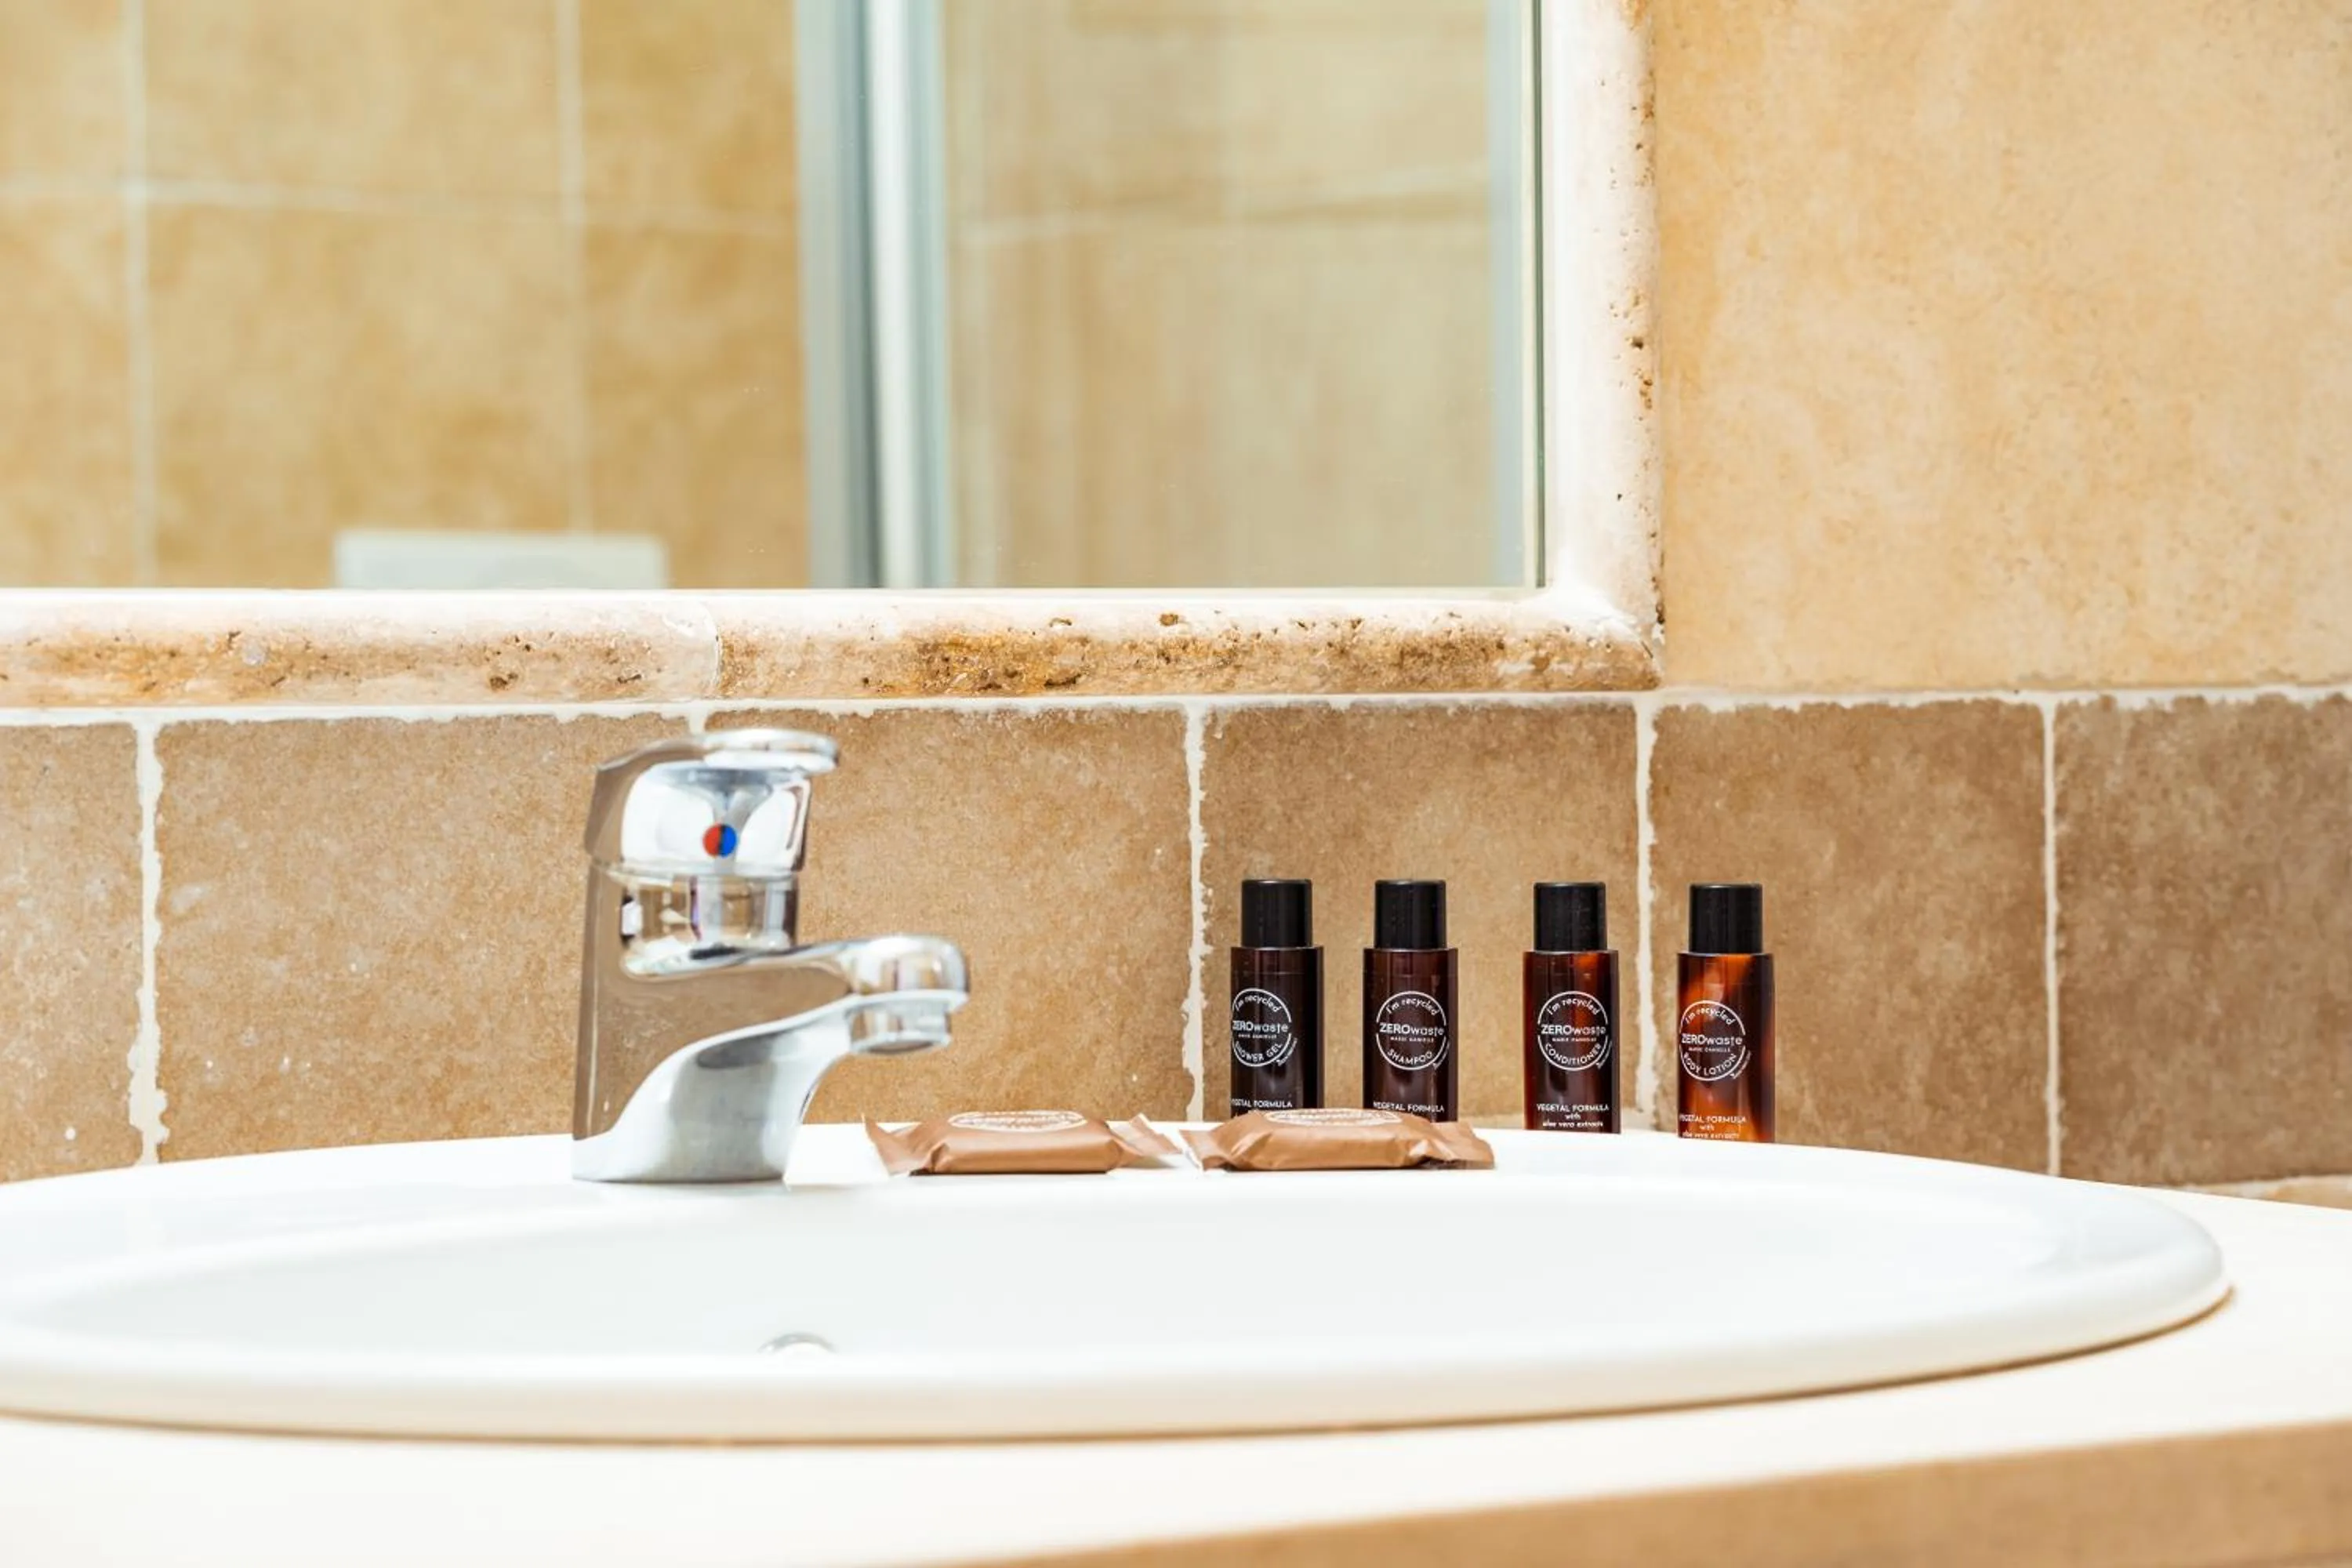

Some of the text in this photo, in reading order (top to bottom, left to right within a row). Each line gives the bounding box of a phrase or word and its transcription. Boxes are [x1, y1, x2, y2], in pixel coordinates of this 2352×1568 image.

[1401, 998, 1441, 1015] recycled
[1562, 998, 1600, 1015] recycled
[1379, 1022, 1445, 1037] ZEROwaste
[1541, 1024, 1606, 1037] ZEROwaste
[1681, 1033, 1743, 1047] ZEROwaste
[1266, 1044, 1283, 1058] GEL
[1387, 1048, 1433, 1065] SHAMPOO
[1545, 1043, 1602, 1065] CONDITIONER
[1703, 1053, 1737, 1076] LOTION
[1254, 1100, 1293, 1109] FORMULA
[1407, 1104, 1445, 1112] FORMULA
[1537, 1103, 1609, 1112] VEGETAL FORMULA
[1707, 1116, 1746, 1124] FORMULA
